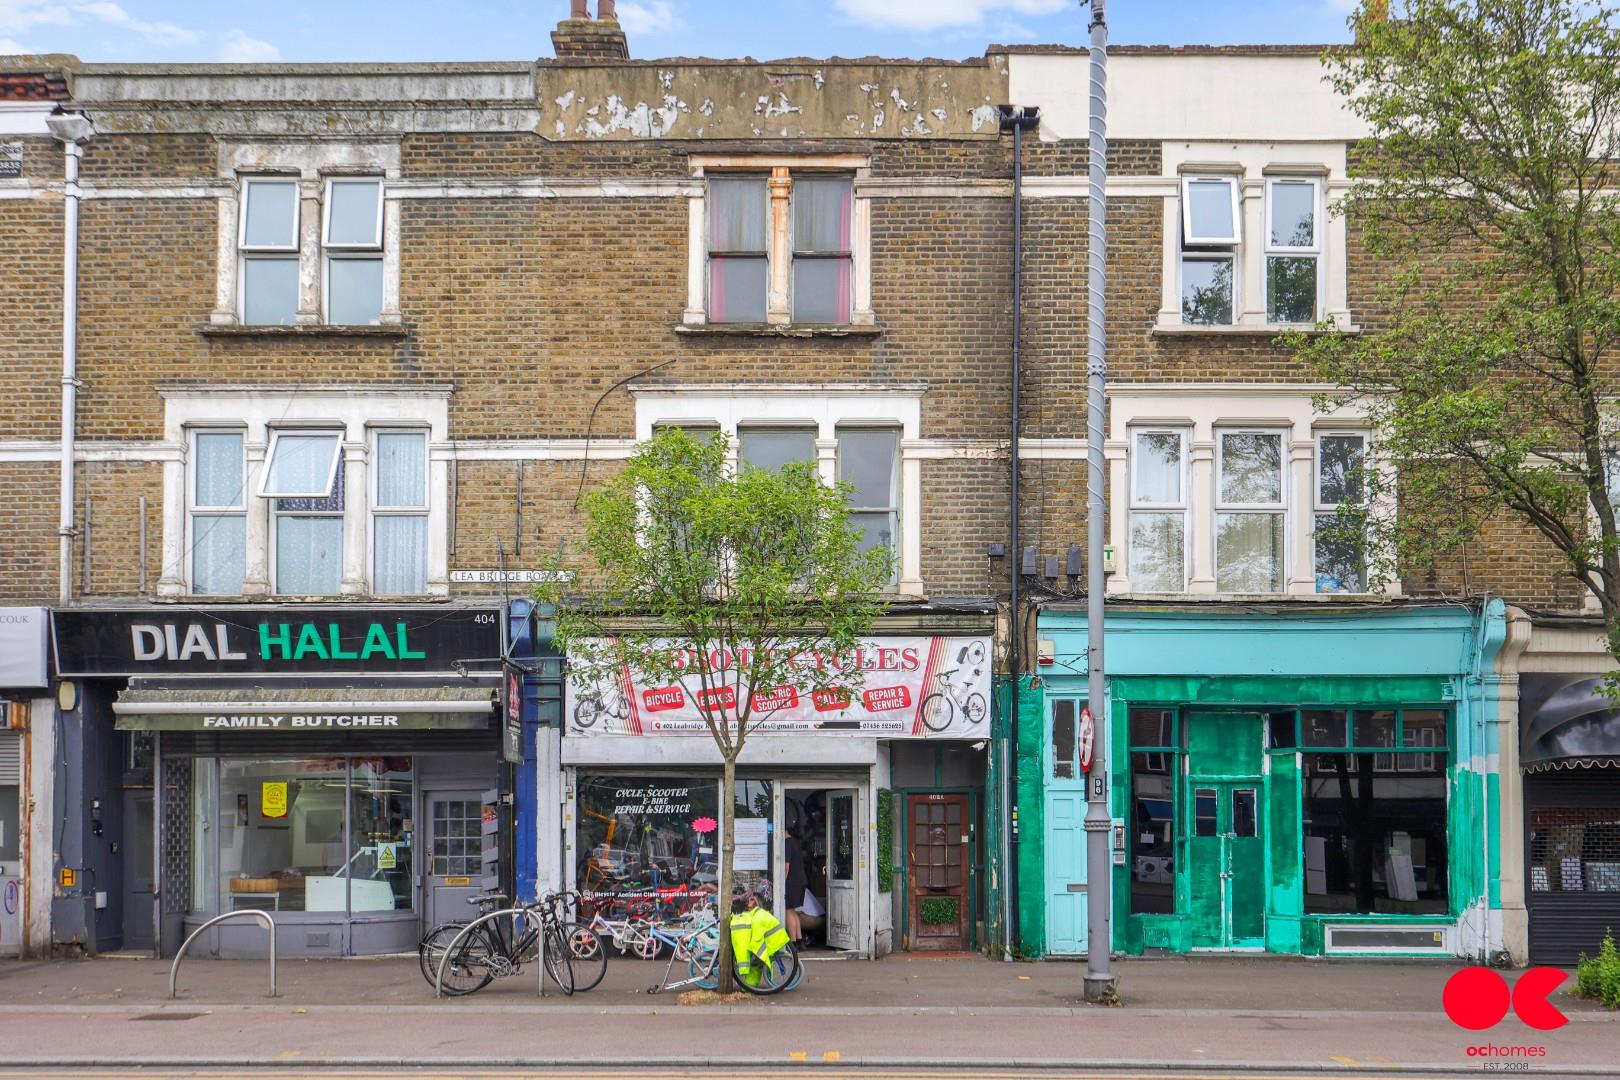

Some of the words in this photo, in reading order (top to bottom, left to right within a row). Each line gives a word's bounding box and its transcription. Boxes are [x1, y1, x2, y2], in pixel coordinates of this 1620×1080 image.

[455, 572, 474, 581] LEA
[479, 572, 521, 581] BRIDGE
[526, 572, 556, 581] ROA
[474, 614, 495, 625] 404
[130, 624, 248, 661] DIAL
[258, 623, 426, 660] HALAL
[646, 692, 682, 706] BICYCLE
[868, 689, 896, 701] REPAIR
[897, 687, 905, 697] &
[872, 700, 905, 711] SERVICE
[203, 715, 285, 728] FAMILY
[290, 714, 399, 728] BUTCHER
[646, 788, 689, 798] SCOOTER
[642, 797, 669, 805] E-BIKE
[614, 805, 645, 815] REPAIR
[62, 870, 74, 885] H
